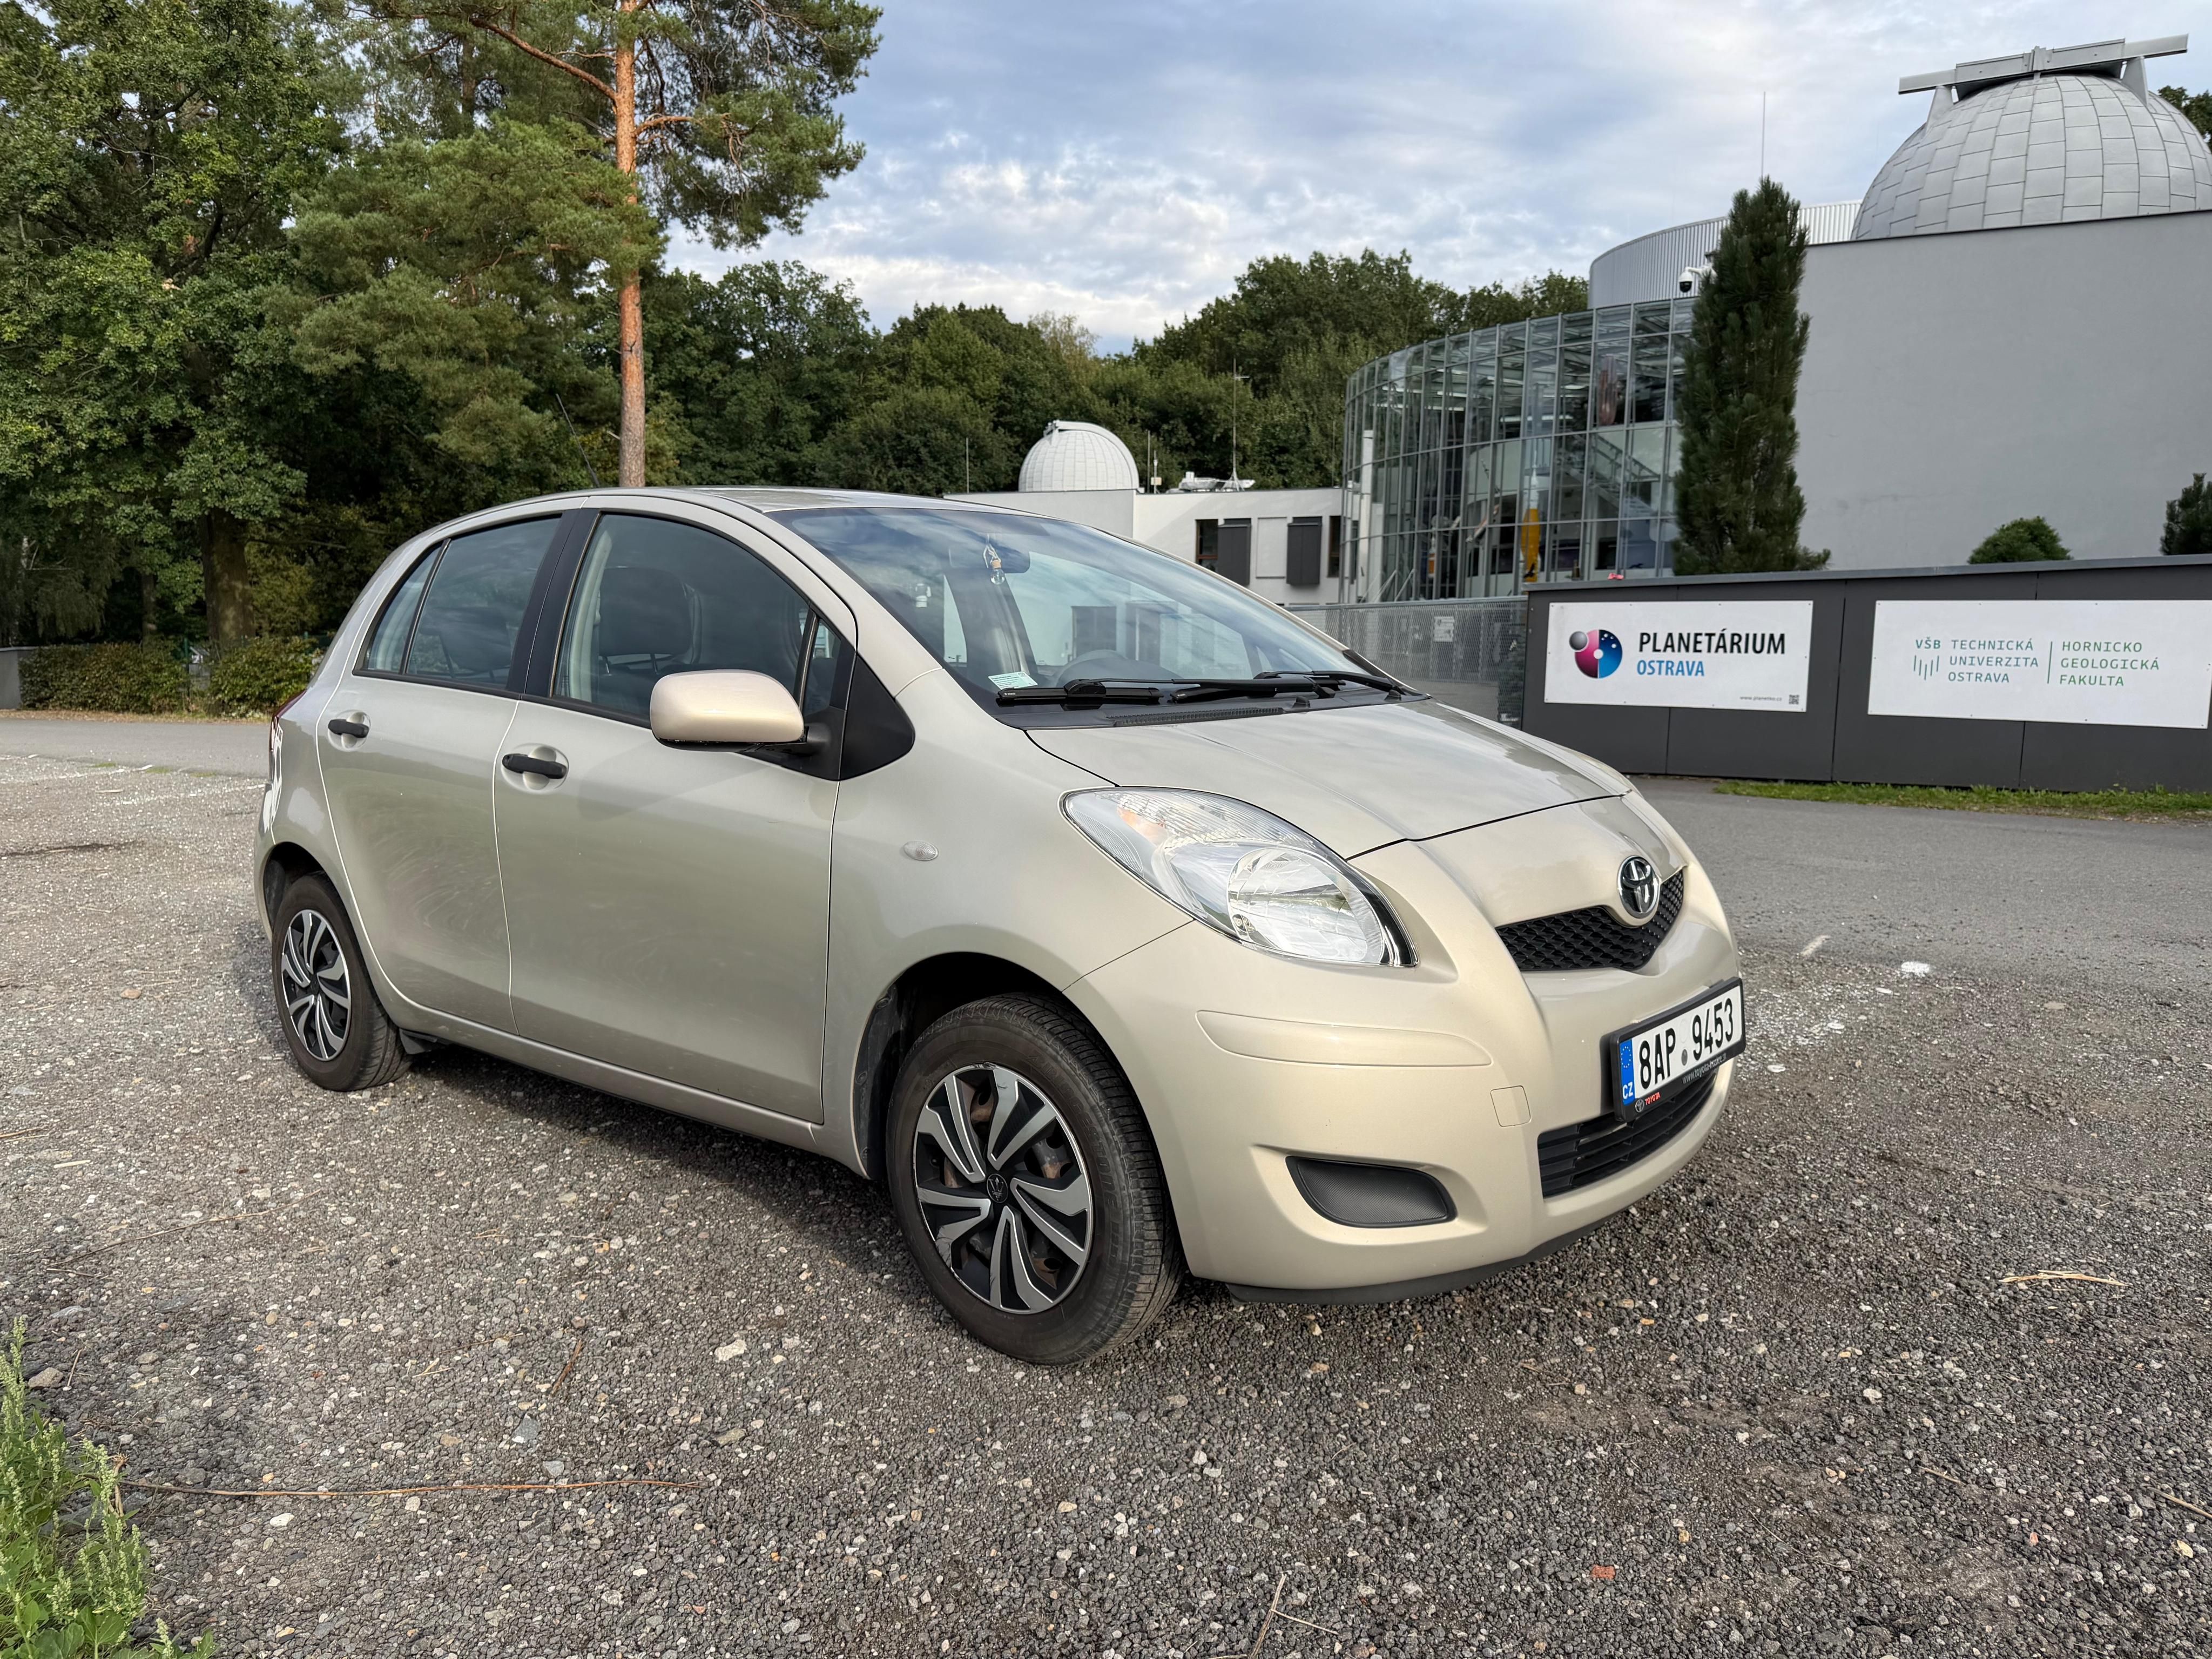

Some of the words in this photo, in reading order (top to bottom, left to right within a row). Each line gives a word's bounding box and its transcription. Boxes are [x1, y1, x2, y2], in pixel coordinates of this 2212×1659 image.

[1638, 628, 1785, 655] PLANETÁRIUM
[1915, 636, 1941, 650] VŠB
[1951, 638, 2034, 651] TECHNICKÁ
[2062, 641, 2143, 653] HORNICKO
[1636, 659, 1705, 677] OSTRAVA
[1949, 656, 2039, 668] UNIVERZITA
[2060, 657, 2160, 671] GEOLOGICKÁ
[1947, 672, 2010, 684] OSTRAVA
[2059, 675, 2125, 687] FAKULTA
[1639, 1028, 1676, 1089] 8AP
[1692, 998, 1734, 1061] 9453
[1622, 1082, 1634, 1100] CZ
[1644, 1091, 1661, 1105] TOYOTA
